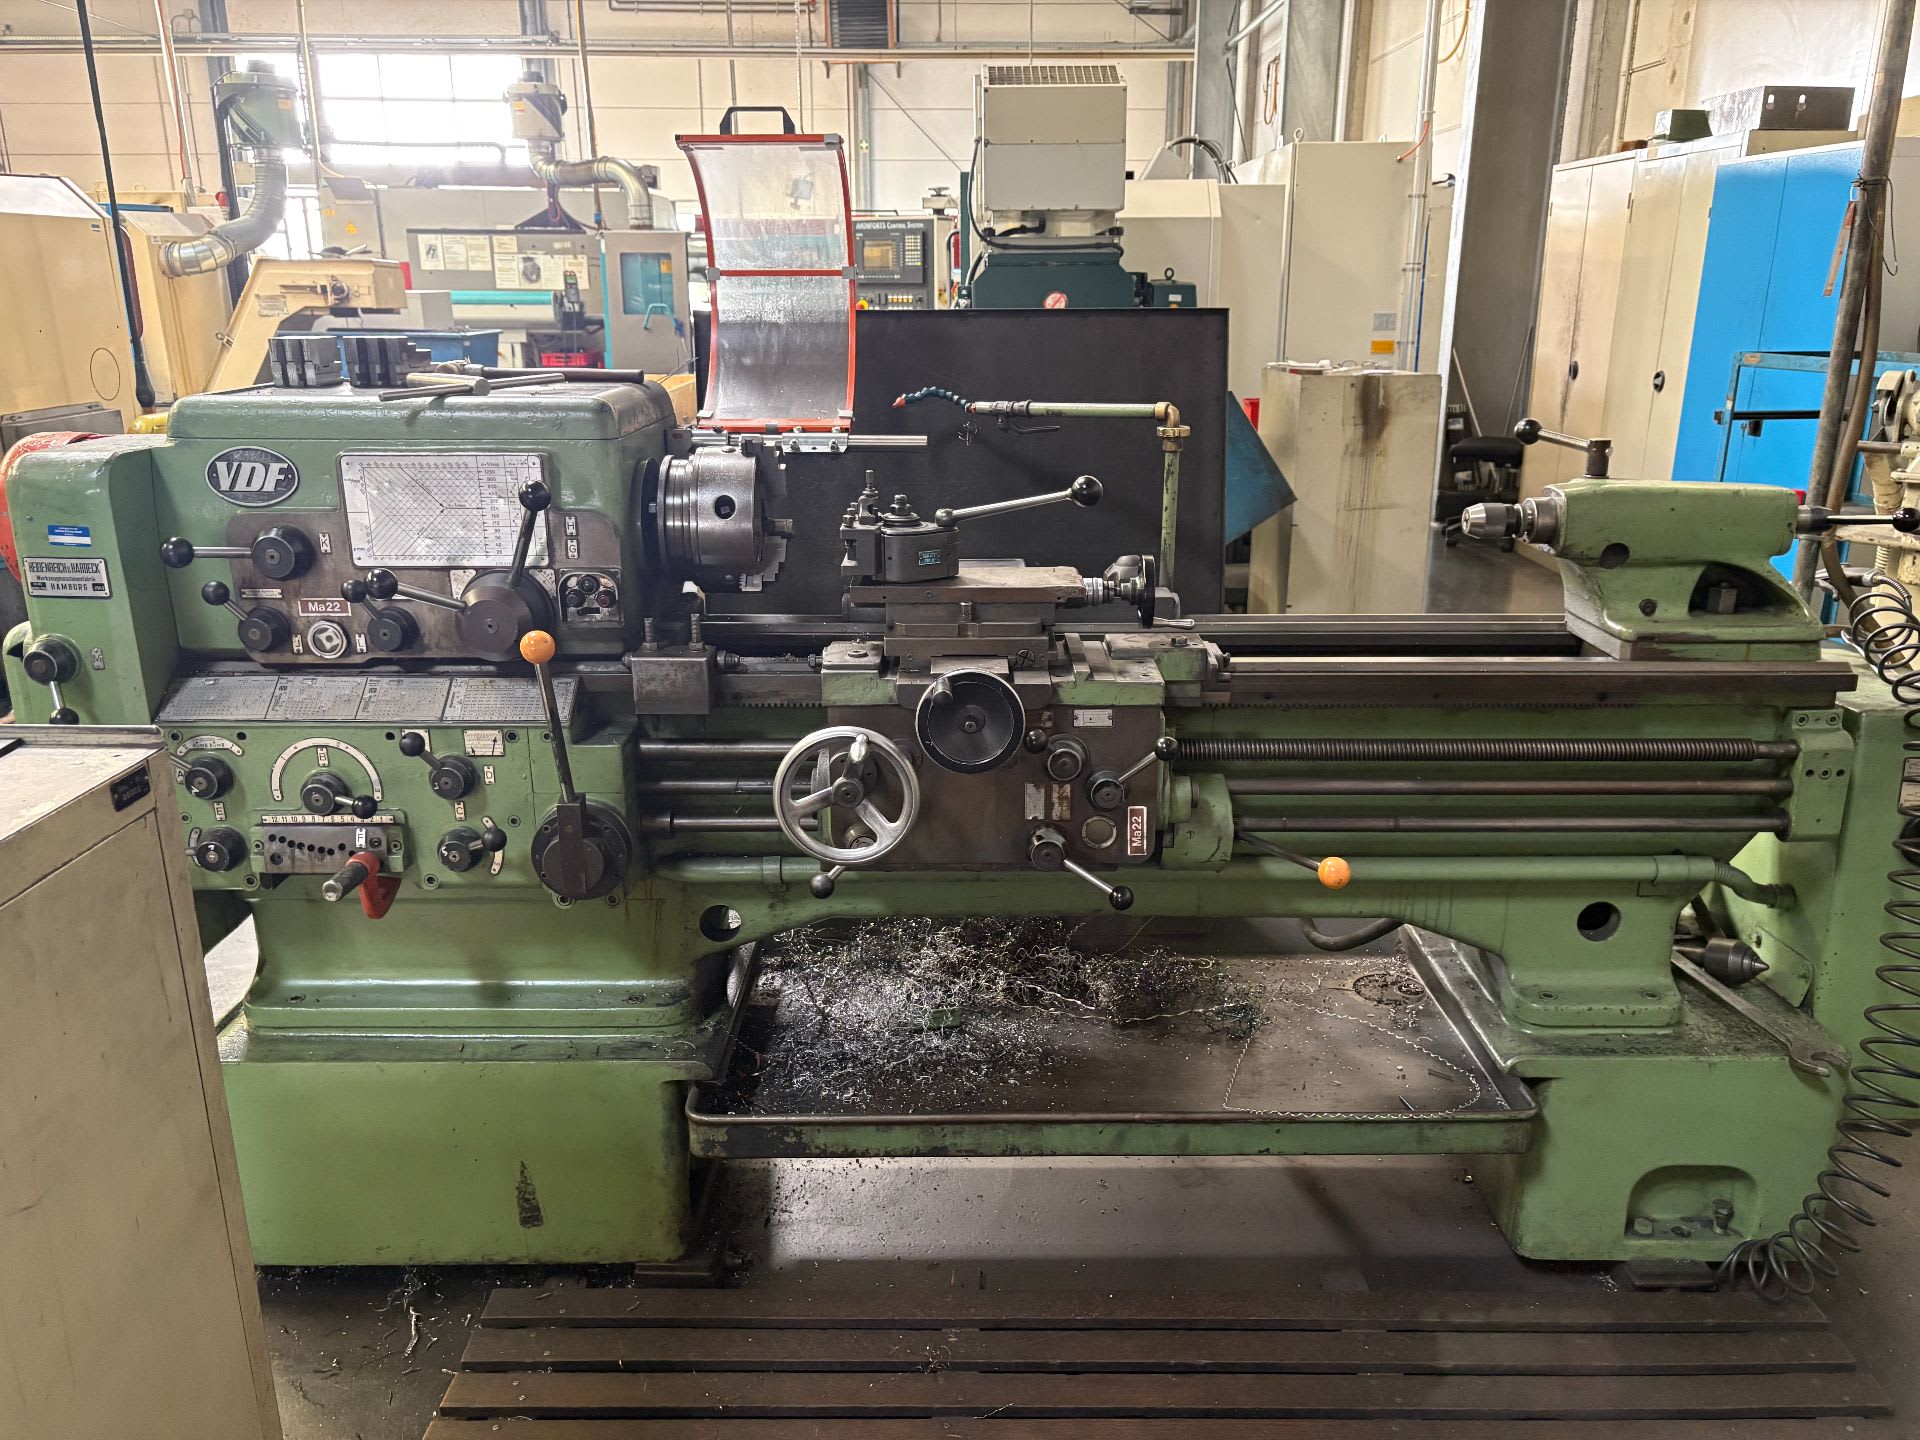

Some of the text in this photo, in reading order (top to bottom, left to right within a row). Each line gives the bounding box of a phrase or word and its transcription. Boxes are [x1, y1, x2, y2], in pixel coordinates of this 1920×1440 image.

[215, 462, 288, 492] VDF
[567, 522, 575, 531] H
[321, 539, 328, 548] K
[568, 544, 577, 554] G
[50, 583, 88, 591] HAMBURG
[308, 602, 341, 612] Ma22
[358, 638, 364, 647] L
[319, 752, 327, 761] B
[177, 769, 184, 777] A
[485, 771, 493, 779] D
[216, 807, 223, 816] E
[456, 806, 463, 815] C
[1131, 815, 1142, 847] Ma22
[357, 833, 364, 842] F
